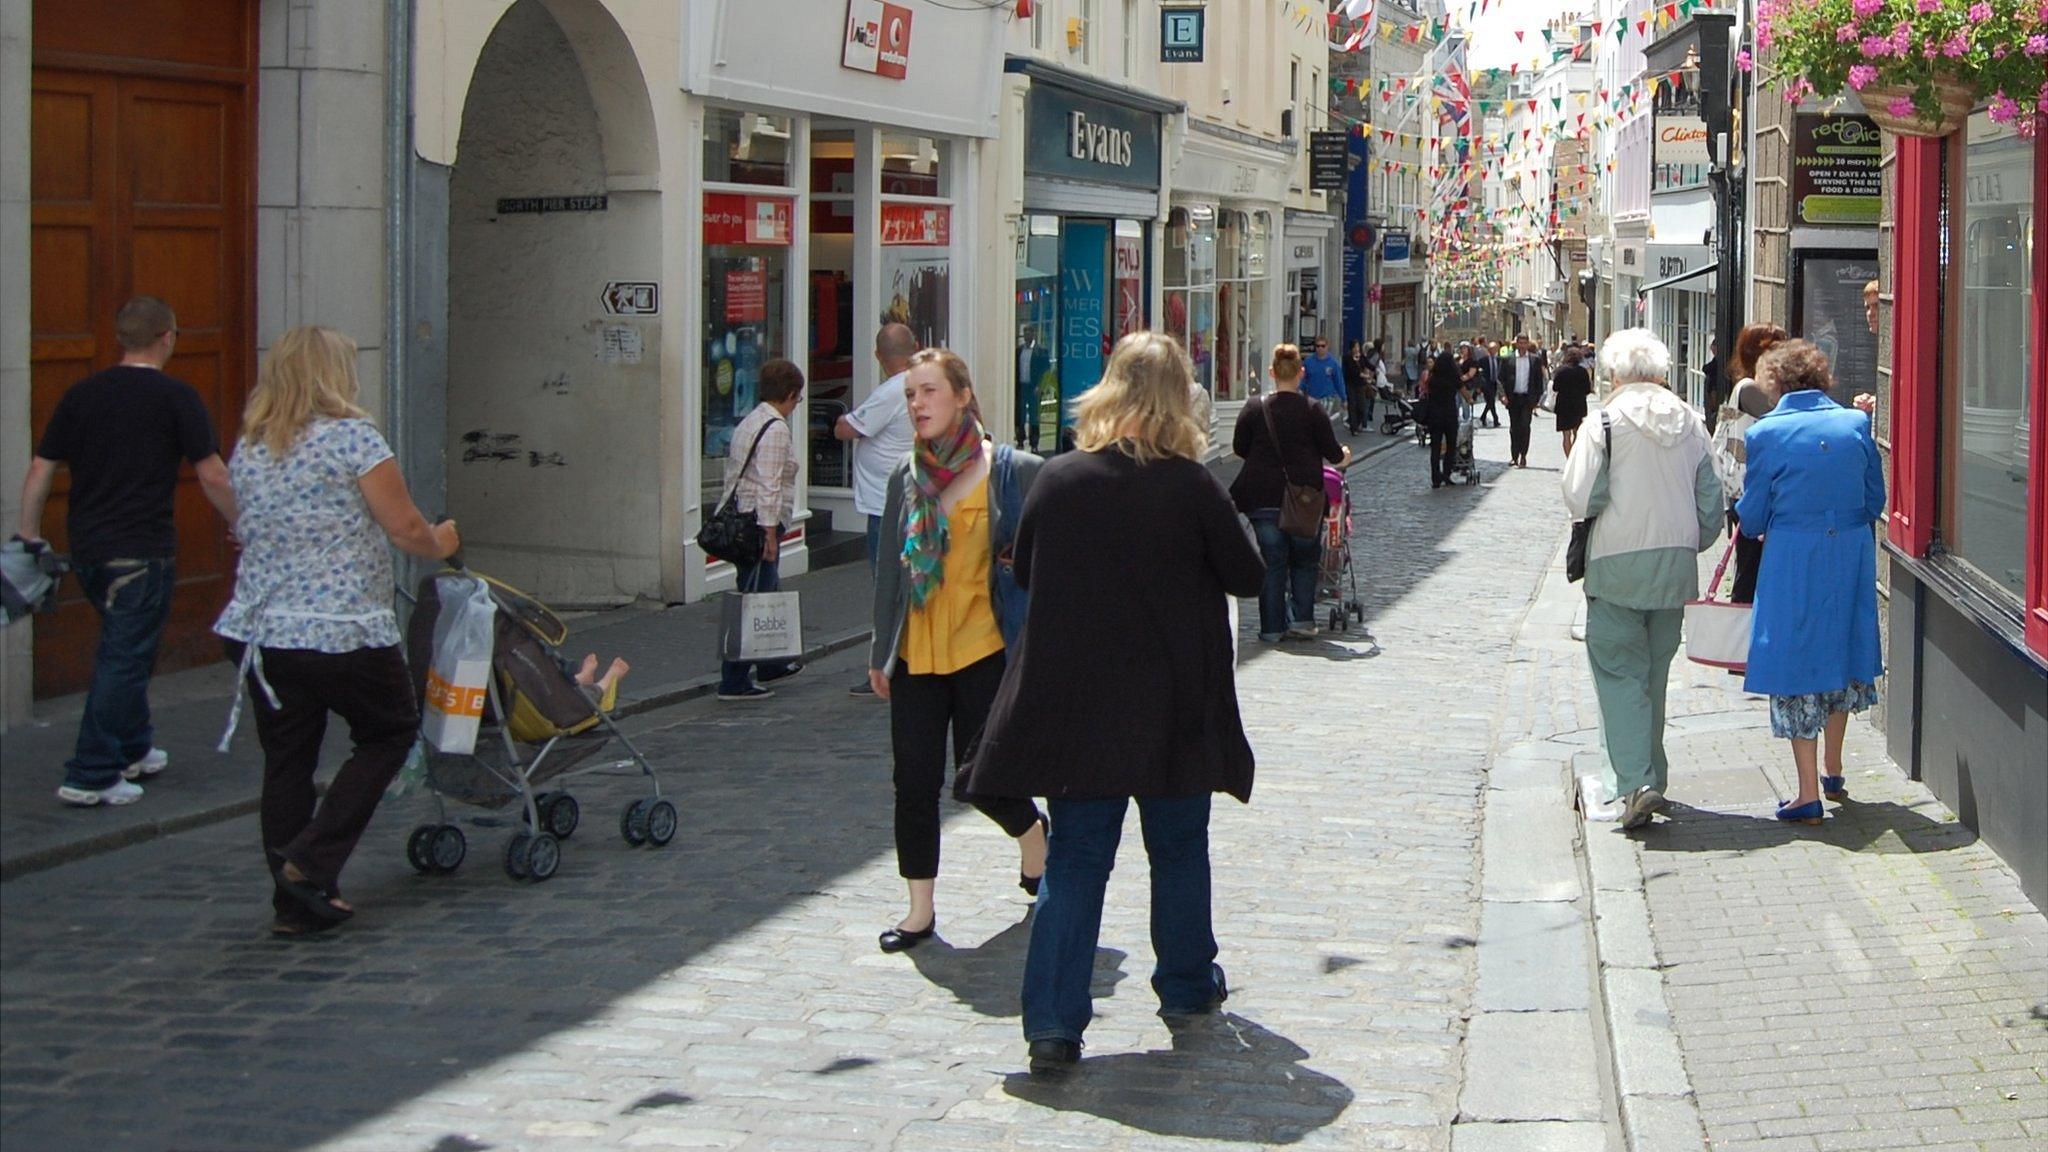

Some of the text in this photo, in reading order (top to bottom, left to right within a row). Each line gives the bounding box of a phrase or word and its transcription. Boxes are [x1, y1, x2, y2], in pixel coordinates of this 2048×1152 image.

[1170, 17, 1192, 42] E
[1165, 49, 1199, 58] Evans
[1071, 110, 1132, 168] Evans
[499, 197, 603, 213] NORTH PIER STEPS
